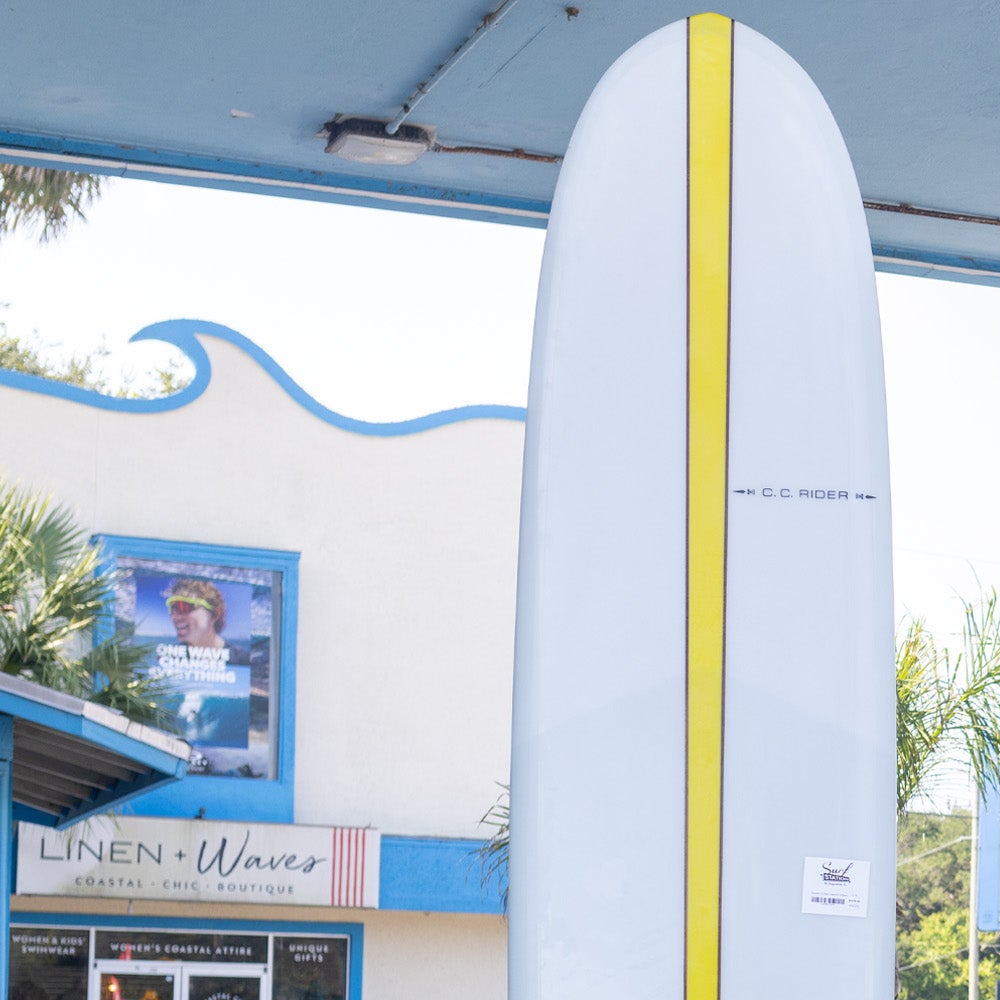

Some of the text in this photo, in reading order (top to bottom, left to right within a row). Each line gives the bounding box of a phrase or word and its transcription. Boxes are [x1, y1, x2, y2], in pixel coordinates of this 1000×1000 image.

[799, 489, 849, 500] RIDER
[156, 643, 230, 661] ONE WAVE
[159, 657, 226, 671] CHANGES
[40, 837, 162, 865] LINEN
[197, 829, 328, 878] Waves
[75, 875, 296, 896] COASTAL CHIC BOUTIQUE
[11, 934, 49, 945] WOMEN
[21, 945, 76, 956] SWIMWEAR
[110, 942, 253, 957] WOMEN'S COASTAL ATTIRE
[288, 943, 329, 955] UNIQUE
[294, 952, 324, 964] GIFTS
